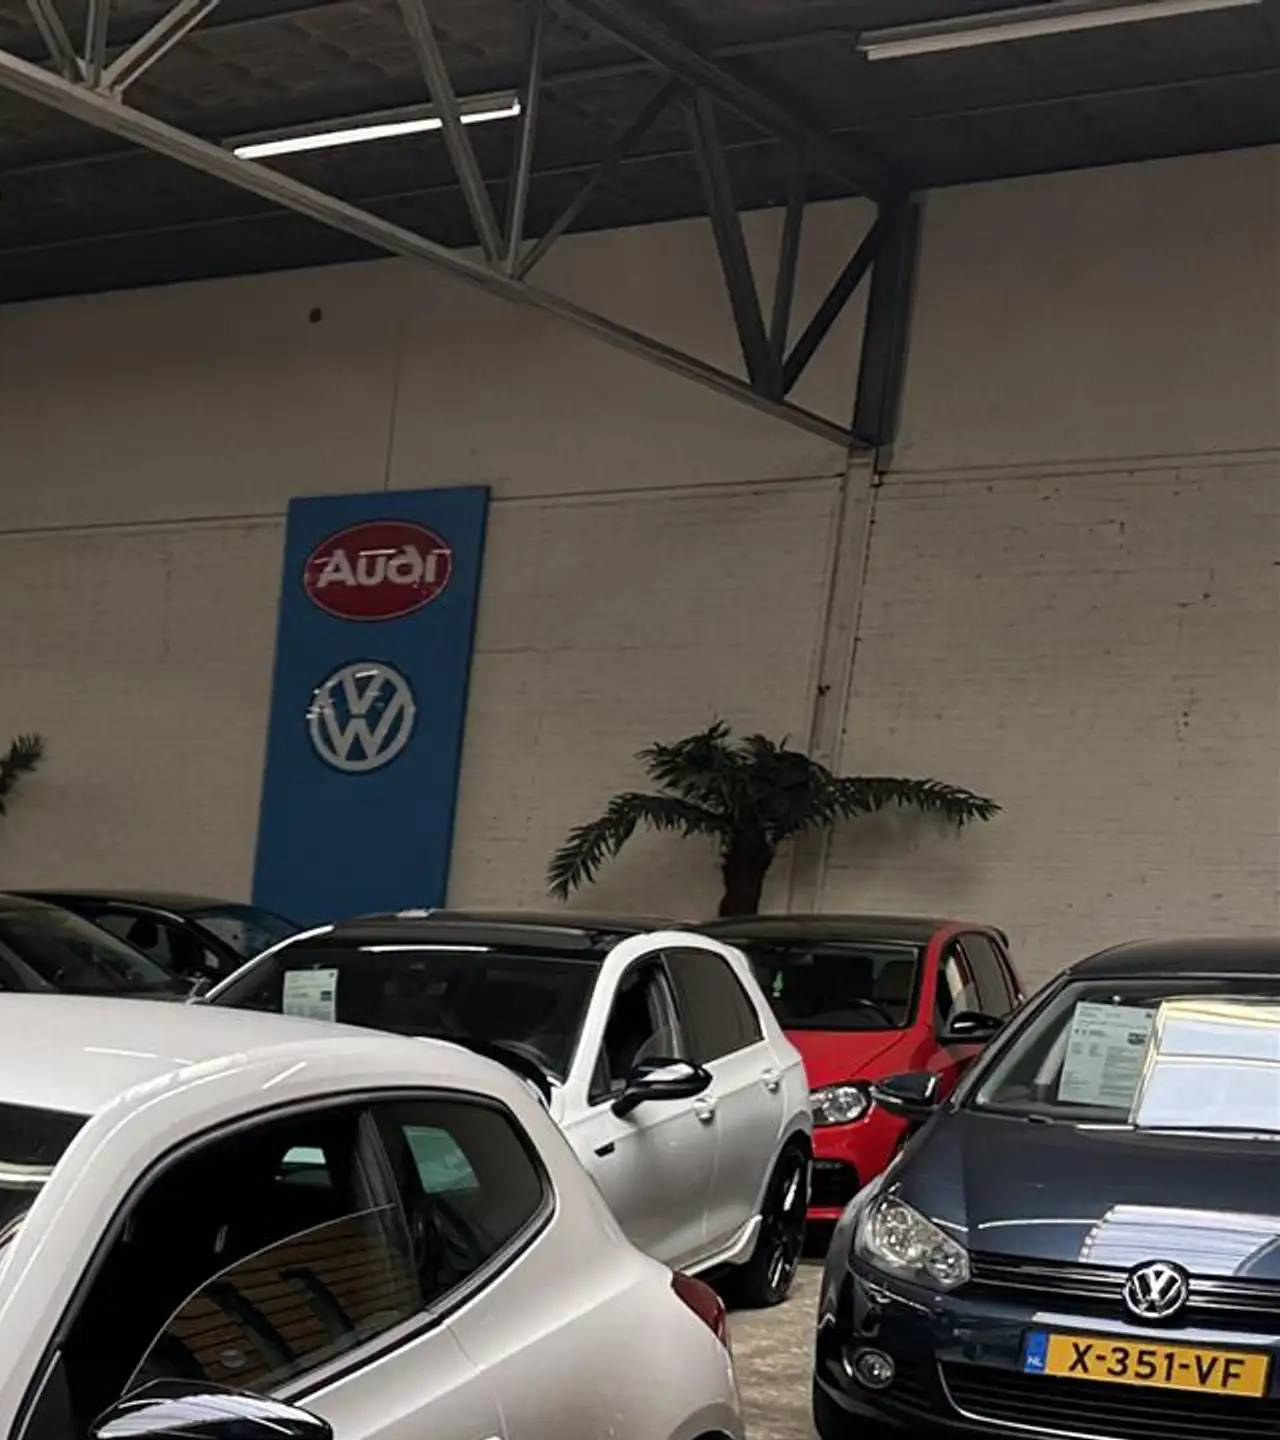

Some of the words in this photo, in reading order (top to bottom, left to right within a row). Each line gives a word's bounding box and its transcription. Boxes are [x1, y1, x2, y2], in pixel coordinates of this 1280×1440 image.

[314, 543, 439, 589] Audi
[1026, 1355, 1044, 1367] NL
[1067, 1341, 1246, 1389] X-351-VF
